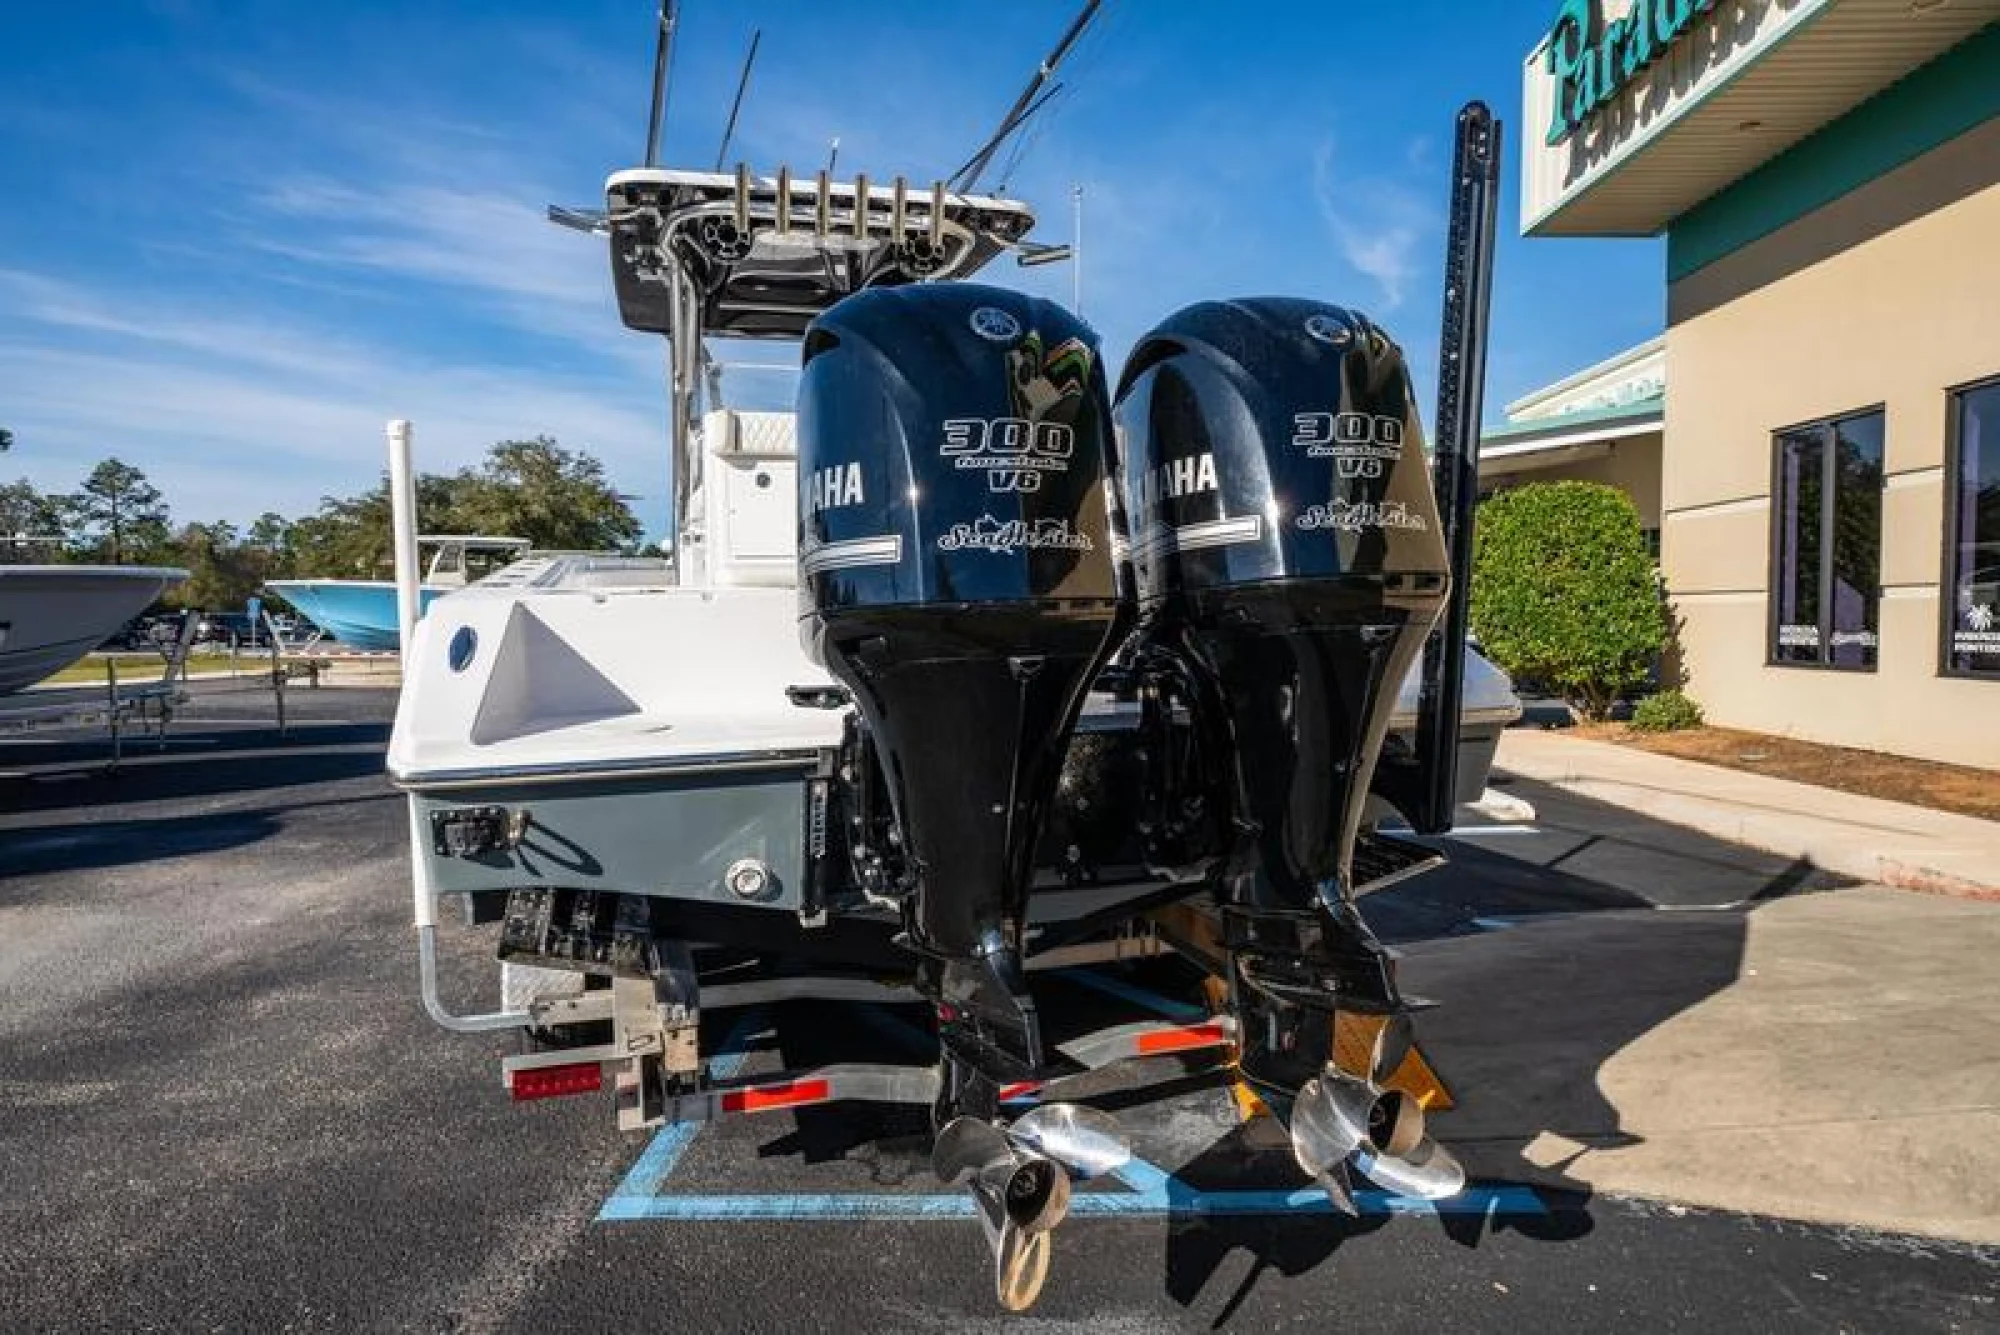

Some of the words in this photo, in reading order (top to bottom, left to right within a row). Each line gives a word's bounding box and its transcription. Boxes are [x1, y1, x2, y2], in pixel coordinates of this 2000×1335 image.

[939, 418, 1074, 458] 300
[1292, 412, 1403, 448] 300
[804, 462, 864, 512] AHA
[988, 469, 1041, 492] V6
[1160, 452, 1219, 498] AHA
